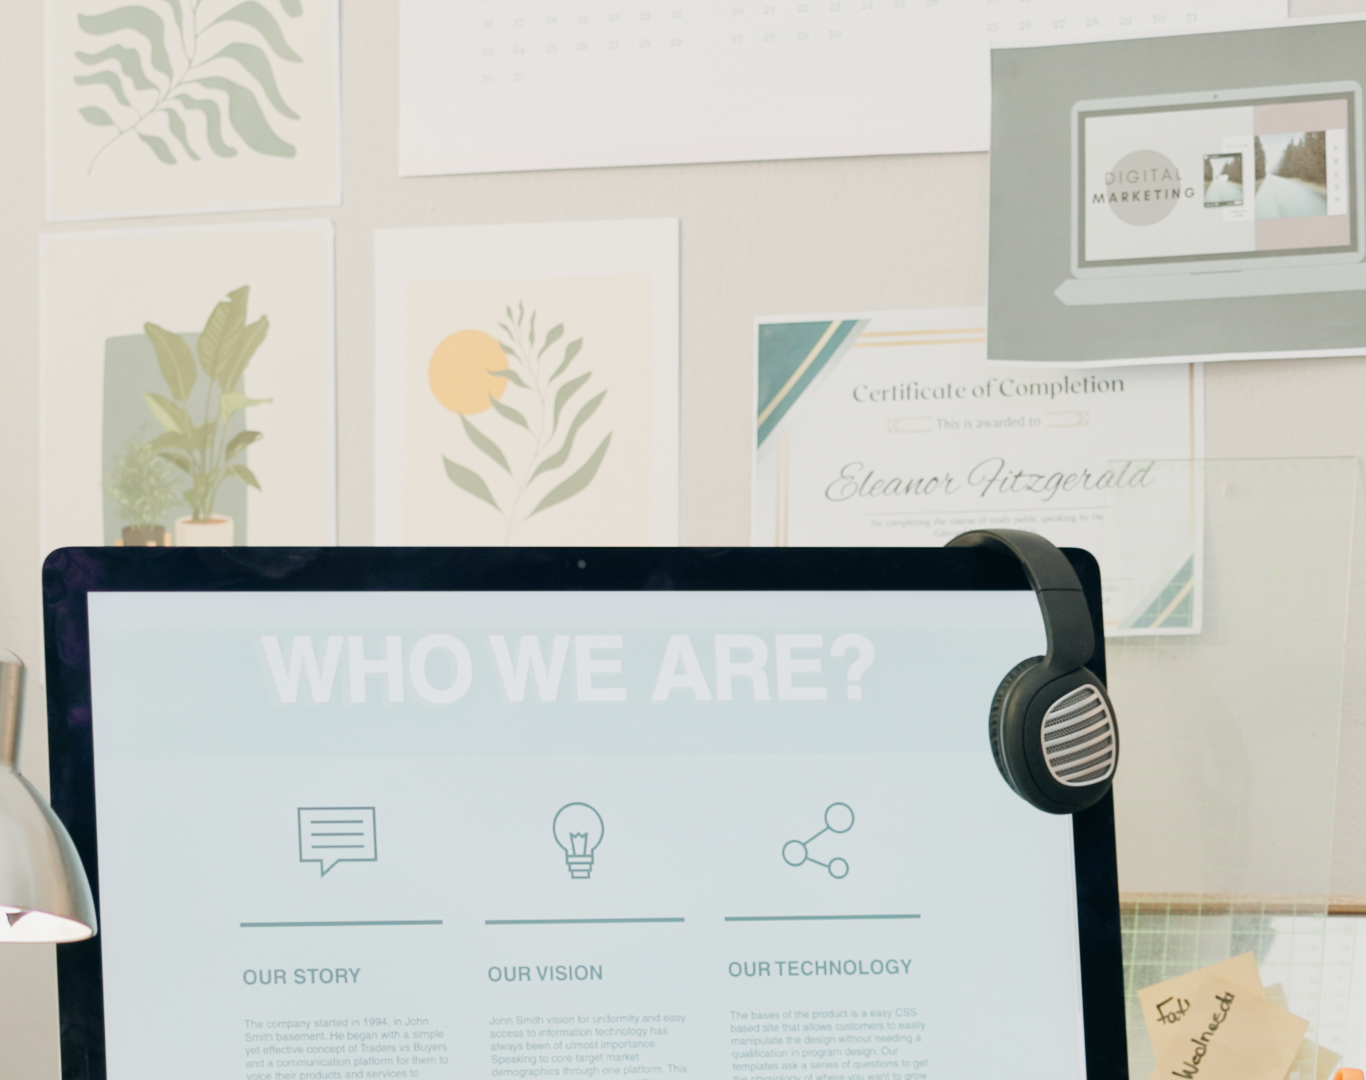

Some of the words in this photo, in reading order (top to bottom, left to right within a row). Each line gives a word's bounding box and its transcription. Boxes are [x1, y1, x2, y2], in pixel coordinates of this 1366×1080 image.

[1105, 167, 1183, 186] DIGITAL
[1092, 187, 1195, 205] MARKETING
[852, 379, 967, 403] Certificate
[971, 377, 994, 399] of
[996, 373, 1125, 402] Completion
[937, 418, 961, 429] This
[964, 417, 973, 429] is
[976, 415, 1025, 429] awarded
[1029, 417, 1041, 427] to
[825, 461, 959, 502] Eleanor
[967, 457, 1158, 502] Fitzgerald
[260, 632, 472, 704] WHO
[486, 632, 628, 703] WE
[648, 632, 876, 701] ARE?
[488, 965, 531, 983] OUR
[536, 964, 603, 981] VISION
[728, 961, 771, 979] OUR
[775, 956, 913, 978] TECHNOLOGY
[243, 969, 287, 985] OUR
[294, 967, 361, 985] STORY
[488, 1016, 514, 1025] John
[515, 1015, 545, 1025] Smith
[546, 1015, 576, 1025] vision
[576, 1015, 590, 1024] for
[592, 1014, 641, 1026] uniformity
[641, 1014, 662, 1023] and
[662, 1015, 687, 1025] easy
[730, 1011, 749, 1020] The
[750, 1010, 781, 1020] bases
[782, 1010, 793, 1019] of
[793, 1010, 811, 1019] the
[811, 1009, 849, 1021] product
[850, 1009, 859, 1018] is
[869, 1010, 893, 1020] easy
[894, 1008, 918, 1017] CSS
[244, 1019, 264, 1029] The
[265, 1021, 312, 1031] company
[313, 1018, 349, 1027] started
[350, 1017, 361, 1027] in
[363, 1017, 391, 1028] 1994,
[392, 1017, 403, 1026] in
[404, 1016, 430, 1026] John
[729, 1023, 761, 1033] based
[762, 1023, 780, 1032] site
[781, 1023, 801, 1032] that
[802, 1022, 833, 1032] allows
[834, 1021, 885, 1031] customers
[886, 1021, 897, 1030] to
[898, 1021, 927, 1032] easily
[244, 1032, 274, 1042] Smith
[275, 1031, 328, 1041] basement.
[329, 1031, 345, 1041] He
[346, 1030, 379, 1043] began
[380, 1030, 401, 1040] with
[412, 1029, 445, 1041] simple
[526, 1028, 537, 1038] to
[538, 1028, 593, 1038] information
[594, 1027, 648, 1039] technology
[649, 1026, 669, 1036] has
[244, 1046, 261, 1057] yet
[262, 1045, 304, 1055] effective
[305, 1044, 346, 1056] concept
[347, 1044, 358, 1053] of
[361, 1043, 397, 1053] Traders
[412, 1042, 448, 1054] Buyers
